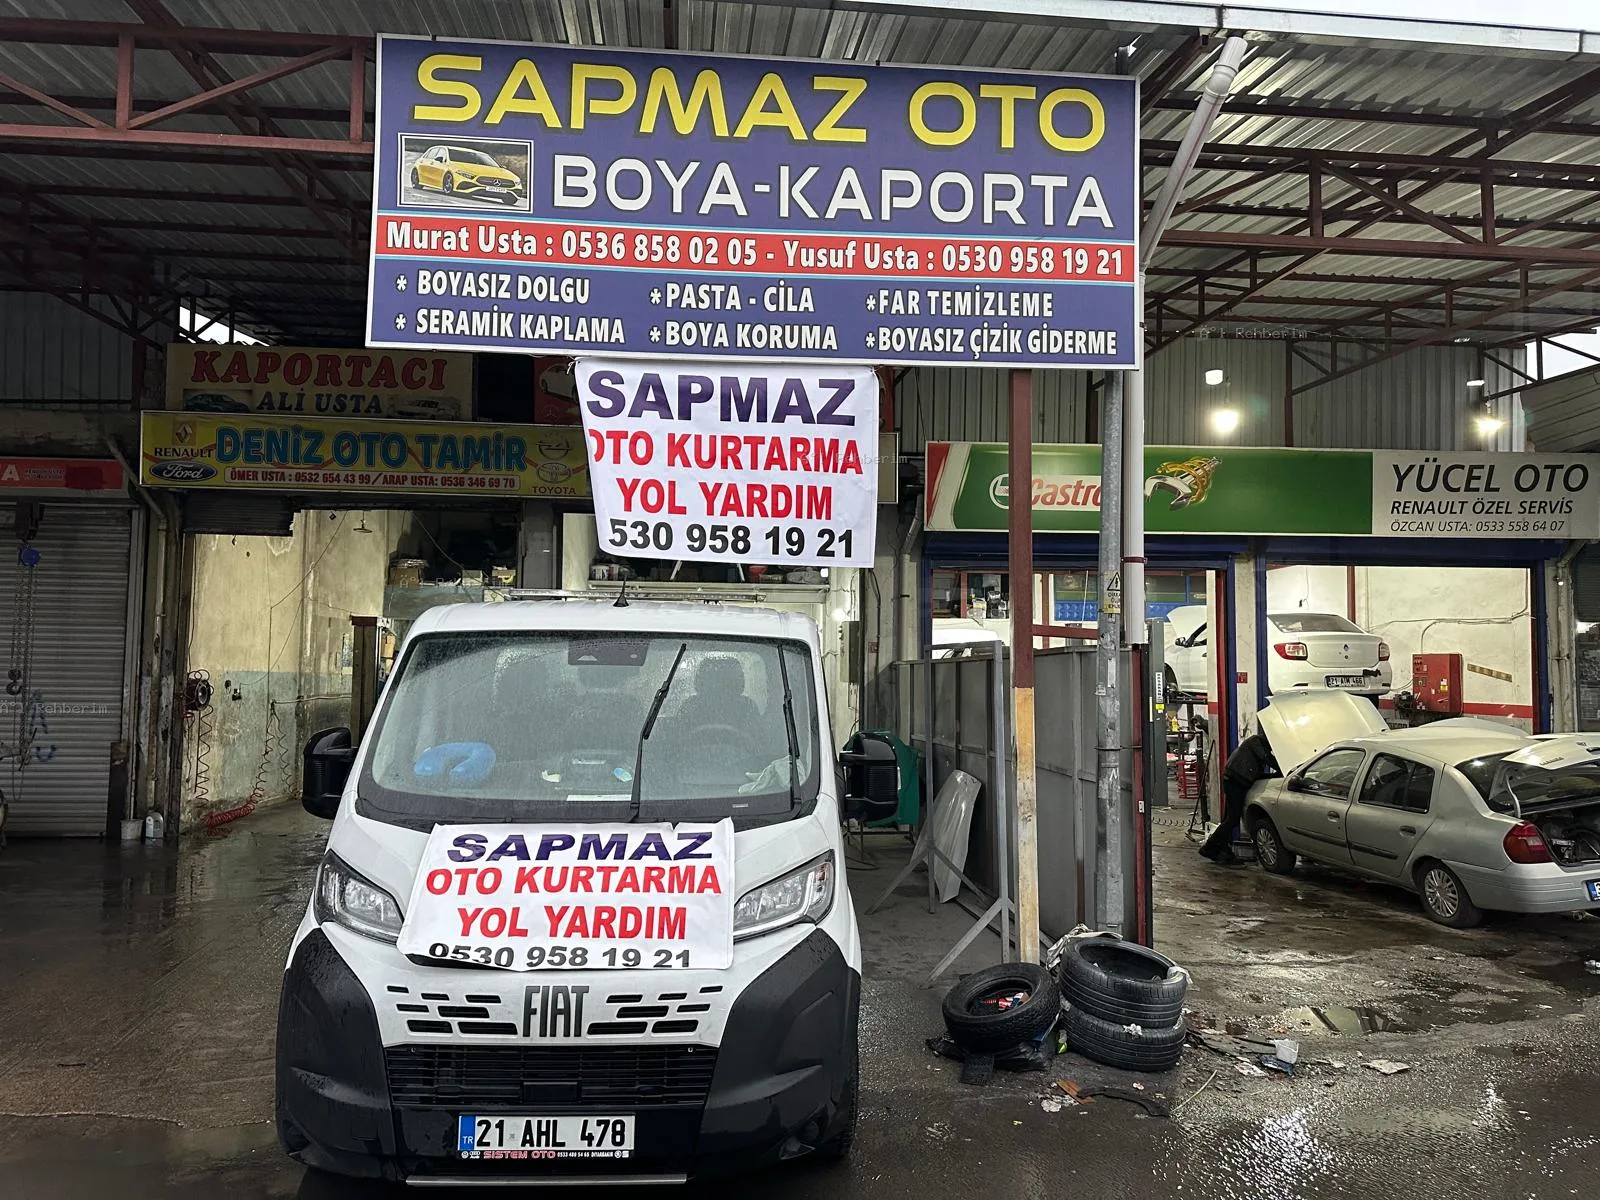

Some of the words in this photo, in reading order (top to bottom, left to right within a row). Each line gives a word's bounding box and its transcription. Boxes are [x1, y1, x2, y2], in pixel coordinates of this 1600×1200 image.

[412, 53, 868, 143] SAPMAZ
[909, 81, 1106, 152] OTO
[552, 153, 1114, 228] BOYA-KAPORTA
[386, 221, 469, 251] Murat
[477, 225, 537, 256] Usta
[561, 229, 626, 261] 0536
[633, 232, 681, 264] 858
[688, 234, 719, 265] 02
[727, 237, 757, 267] 05
[783, 239, 857, 269] Yusuf
[864, 242, 919, 271] Usta
[942, 245, 1003, 273] 0530
[1010, 245, 1055, 274] 958
[1061, 247, 1089, 275] 19
[1096, 248, 1123, 276] 21
[417, 269, 511, 300] BOYASIZ
[517, 276, 590, 304] DOLGU
[666, 282, 741, 311] PASTA
[763, 280, 815, 313] CİLA
[879, 288, 920, 315] FAR
[927, 284, 1053, 317] TEMİZLEME
[416, 304, 514, 339] SERAMİK
[520, 313, 625, 344] KAPLAMA
[665, 320, 729, 348] BOYA
[736, 323, 838, 351] KORUMA
[878, 326, 964, 353] BOYASIZ
[969, 322, 1022, 360] ÇİZİK
[1027, 322, 1117, 355] GİDERME
[190, 350, 447, 390] KAPORTACI
[256, 387, 305, 412] ALİ
[315, 392, 383, 414] USTA
[586, 370, 856, 426] SAPMAZ
[154, 447, 214, 459] RENAULT
[215, 424, 325, 466] DENİZ
[333, 430, 410, 469] OTO
[415, 431, 528, 473] TAMİR
[666, 432, 863, 474] KURTARMA
[162, 462, 203, 480] Ford
[230, 469, 258, 482] ÖMER
[262, 470, 285, 483] USTA
[295, 471, 319, 483] 0532
[322, 472, 340, 484] 654
[343, 473, 356, 484] 43
[441, 476, 465, 487] 0536
[468, 476, 486, 487] 346
[503, 478, 515, 488] 70
[1391, 457, 1501, 492] YÜCEL
[1513, 463, 1589, 492] OTO
[532, 486, 577, 495] TOYOTA
[615, 477, 687, 515] YOL
[699, 482, 832, 520] YARDIM
[1390, 499, 1468, 515] RENAULT
[1472, 497, 1513, 515] ÖZEL
[1518, 497, 1573, 515] SERVİS
[608, 518, 673, 551] 530
[686, 523, 751, 554] 958
[764, 525, 806, 557] 19
[816, 528, 853, 558] 21
[1390, 519, 1434, 532] ÖZCAN
[1438, 521, 1472, 532] USTA:
[1475, 521, 1504, 532] 0533
[1508, 520, 1529, 532] 558
[1532, 520, 1547, 532] 64
[1550, 520, 1565, 532] 07
[446, 831, 713, 863] SAPMAZ
[425, 867, 503, 896] OTO
[514, 865, 722, 894] KURTARMA
[457, 907, 528, 938] YOL
[544, 905, 687, 940] YARDIM
[428, 942, 515, 968] 0530
[526, 946, 589, 968] 958
[602, 947, 642, 968] 19
[653, 949, 691, 968] 21
[522, 985, 590, 1038] FIAT
[462, 1135, 474, 1145] TR
[476, 1119, 505, 1147] 21
[520, 1119, 566, 1148] AHL
[580, 1119, 626, 1148] 478
[531, 1150, 556, 1159] OTO
